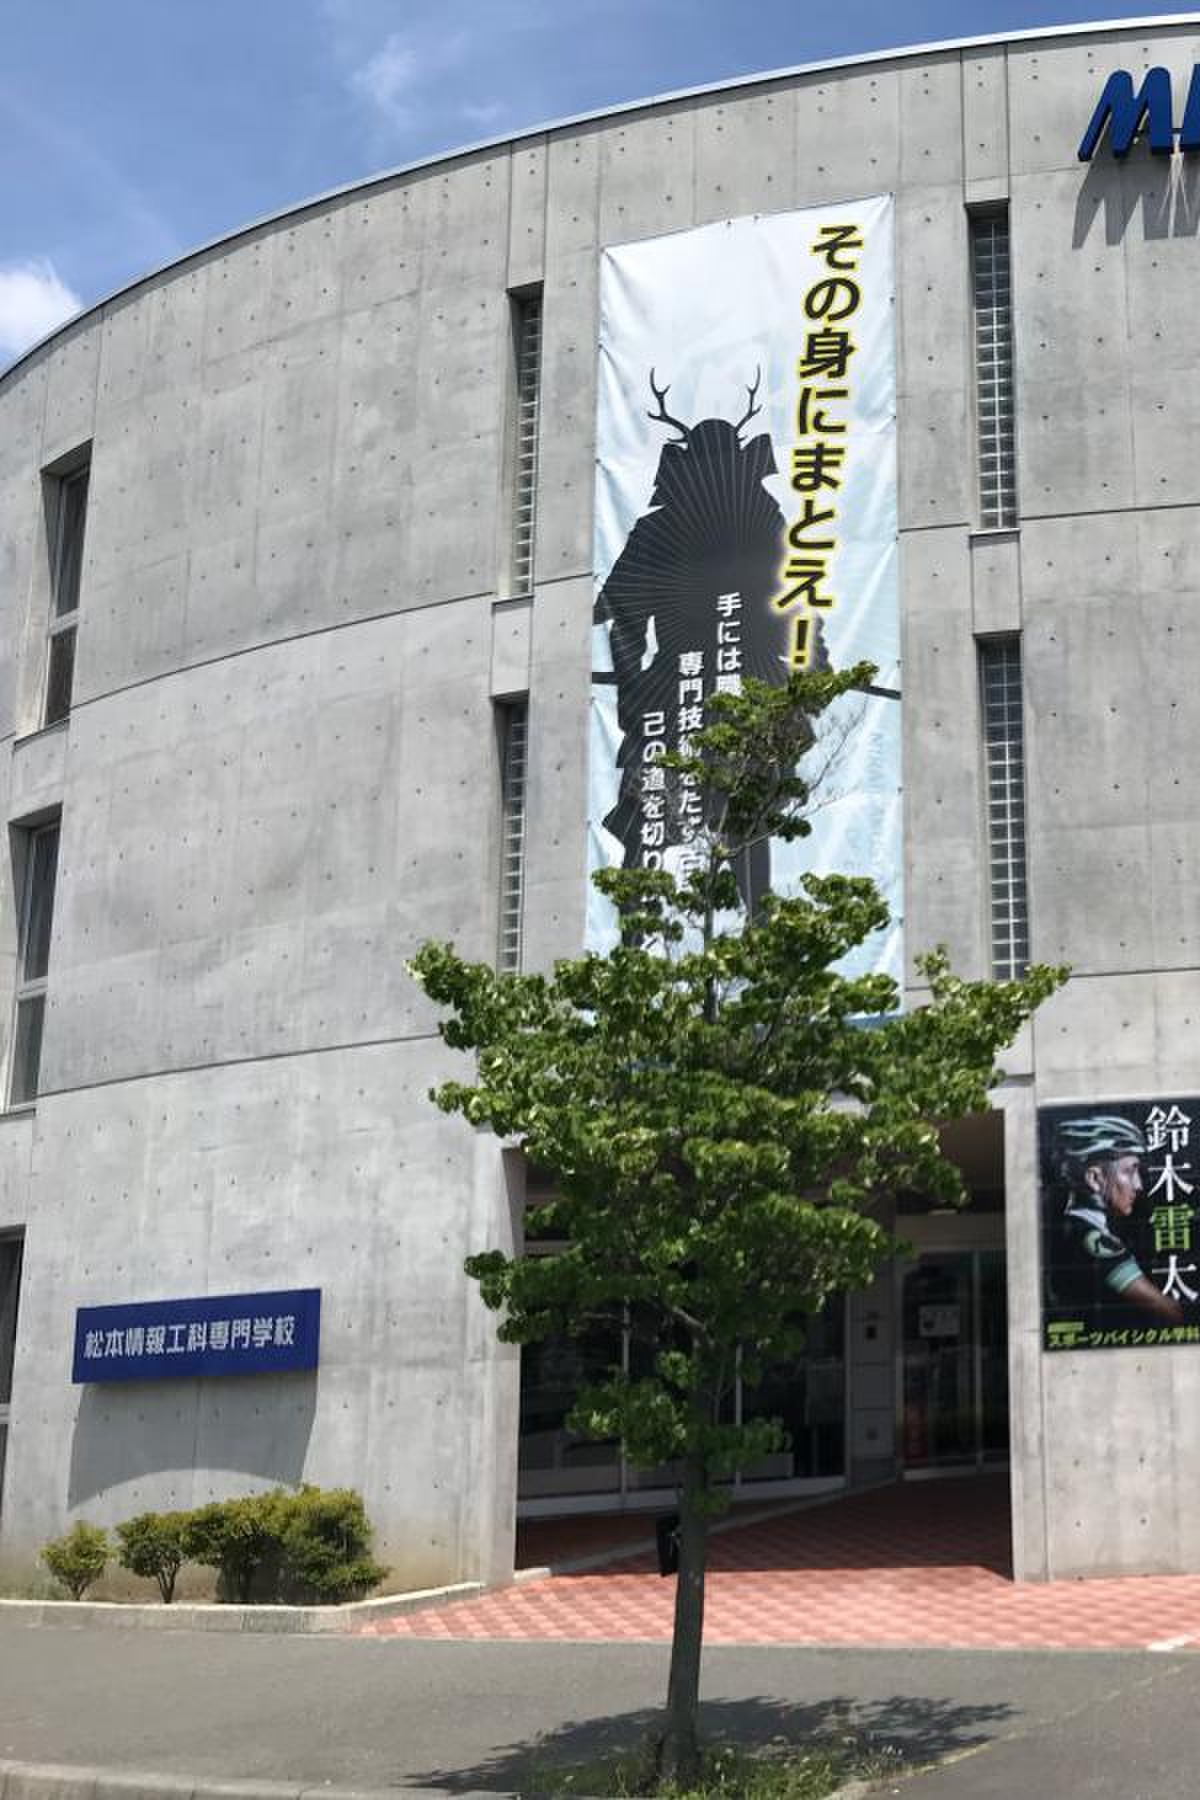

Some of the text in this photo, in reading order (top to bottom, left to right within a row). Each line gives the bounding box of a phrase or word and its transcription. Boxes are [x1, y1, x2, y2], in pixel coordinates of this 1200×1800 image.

[1144, 1105, 1199, 1301] 鈴木雷太
[83, 1315, 295, 1359] 松本情報工科専門学校
